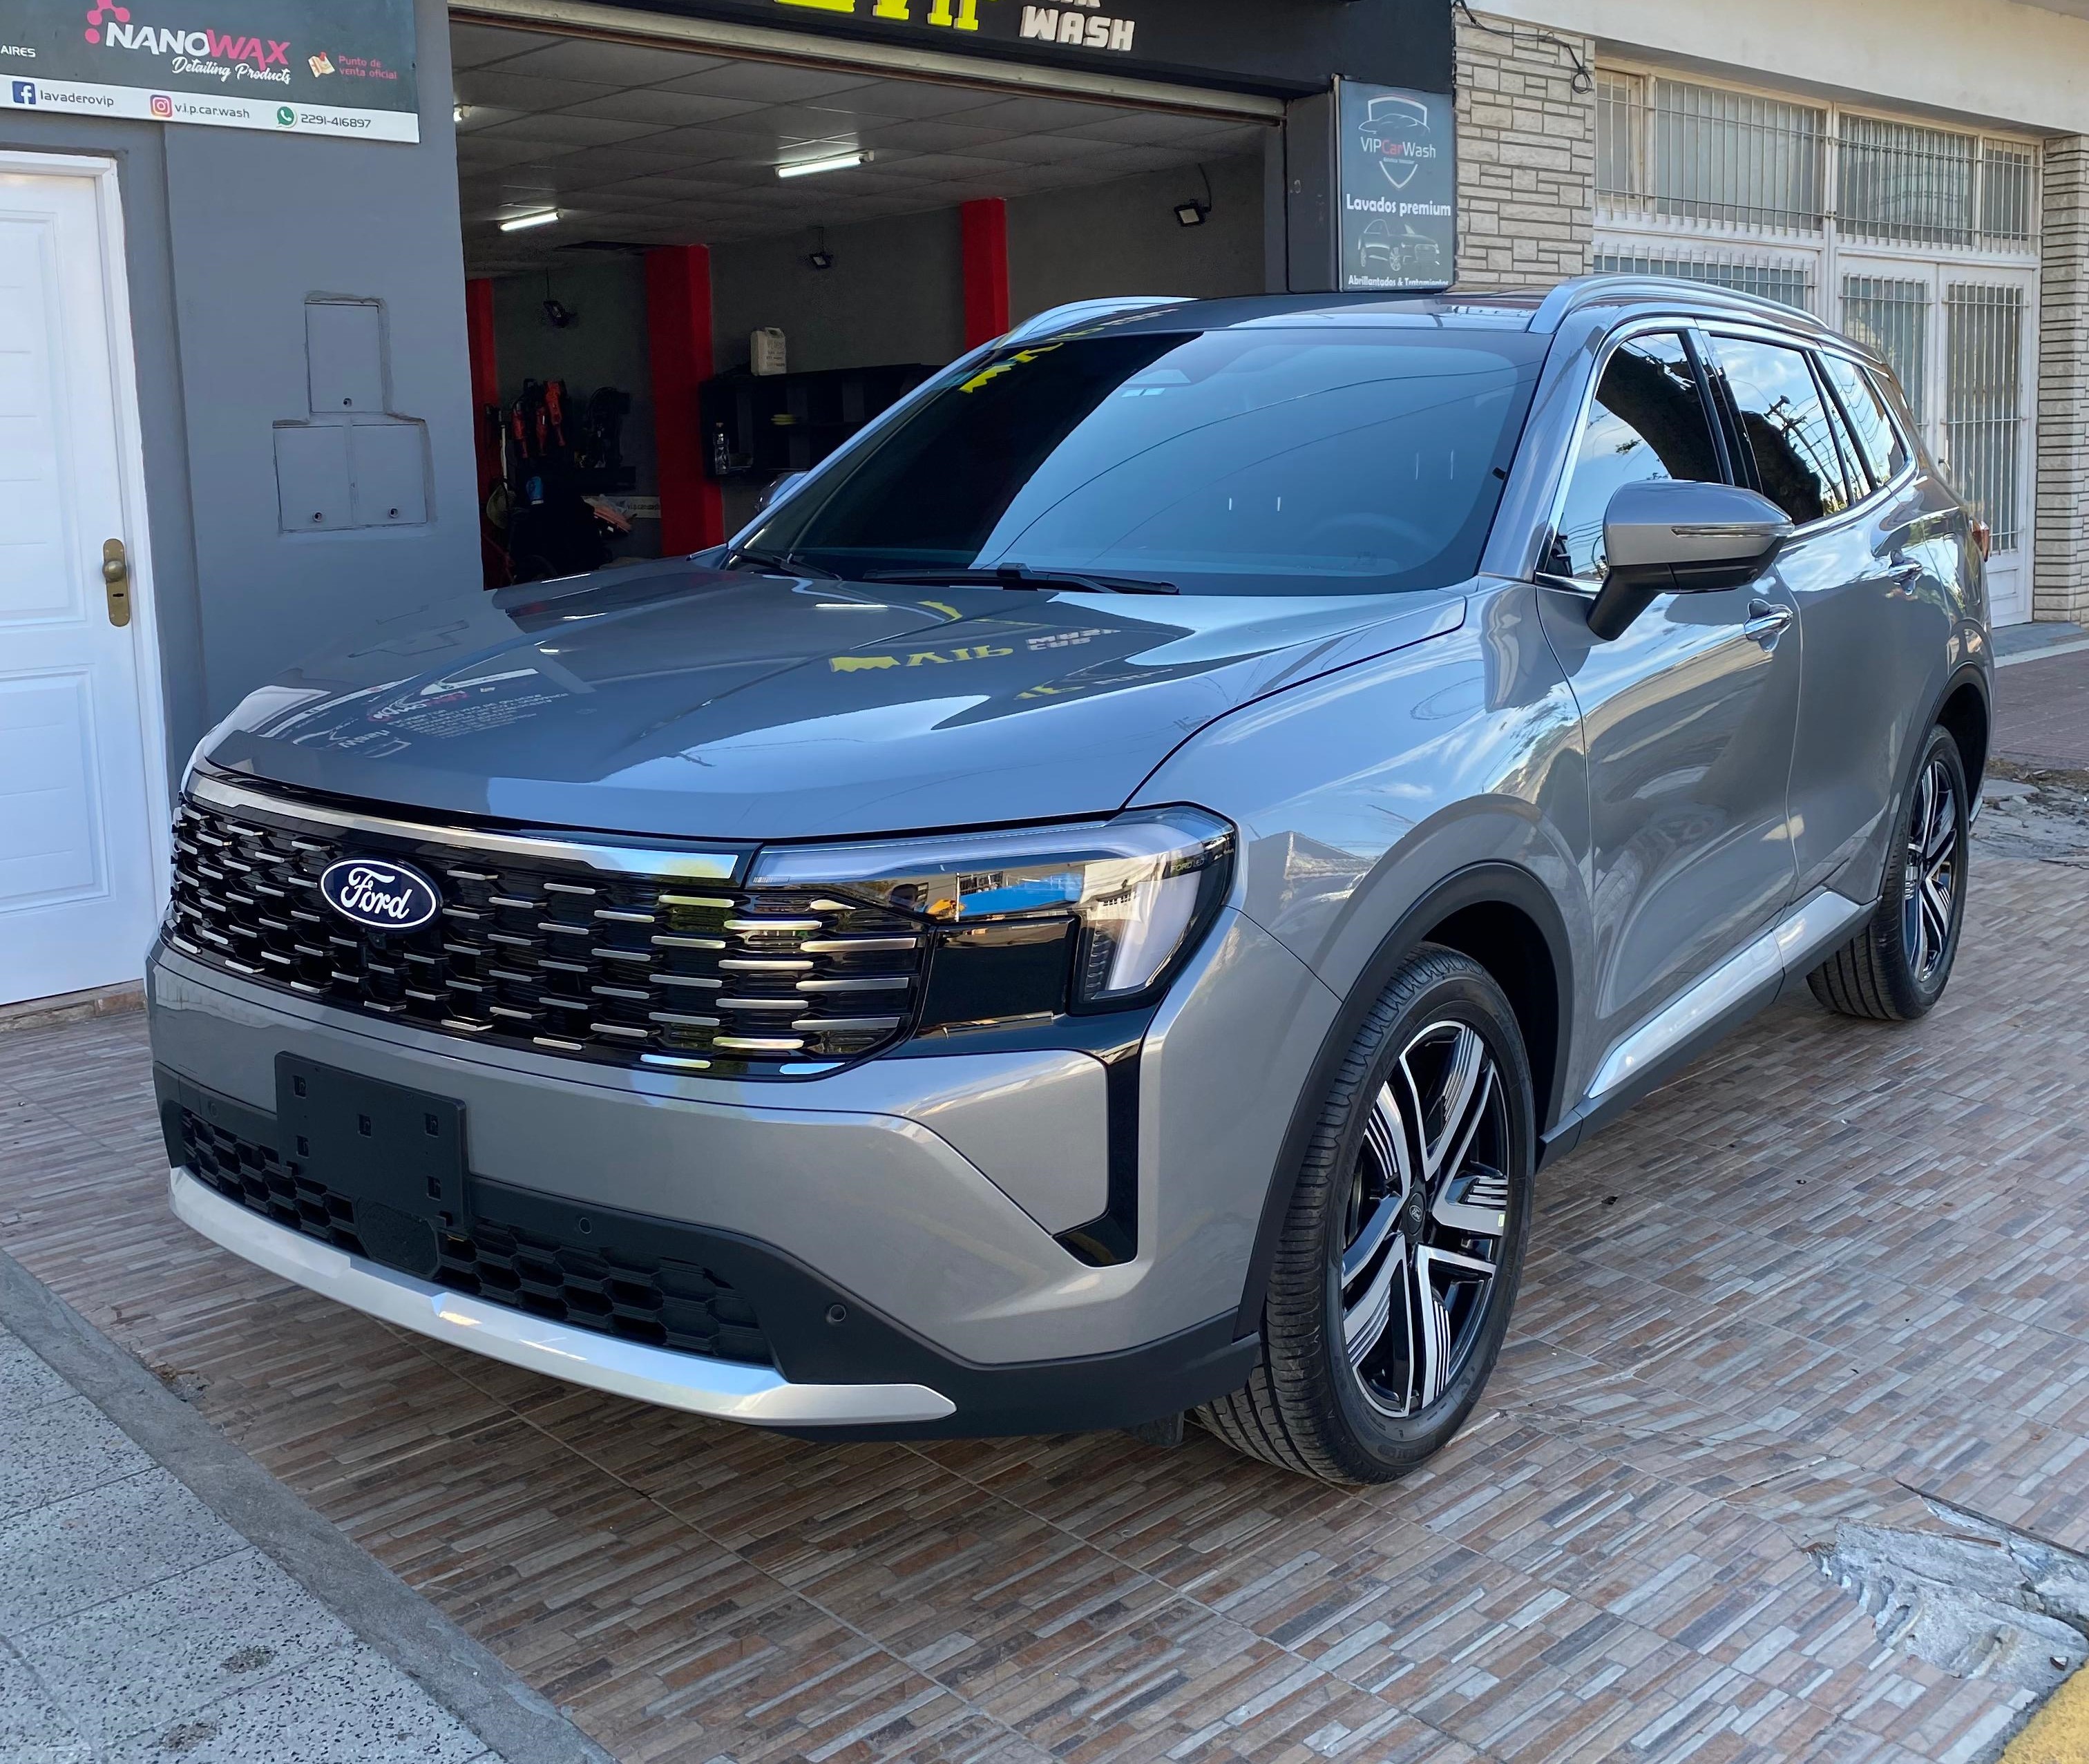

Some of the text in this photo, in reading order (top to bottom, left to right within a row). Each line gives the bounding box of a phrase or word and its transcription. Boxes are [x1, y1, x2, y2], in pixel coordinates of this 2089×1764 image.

[1019, 6, 1135, 51] WASH
[1, 45, 36, 57] AIRES
[106, 22, 290, 71] NANOWAX
[171, 56, 291, 85] Detailing Products
[338, 55, 381, 68] Punto de
[339, 68, 398, 79] venta oficial
[40, 90, 114, 107] lavaderovip
[301, 113, 372, 128] 2291-416897
[1360, 136, 1436, 159] VIPCarWash
[1346, 193, 1451, 217] Lavados premium
[1398, 277, 1403, 286] &
[341, 867, 413, 919] Ford
